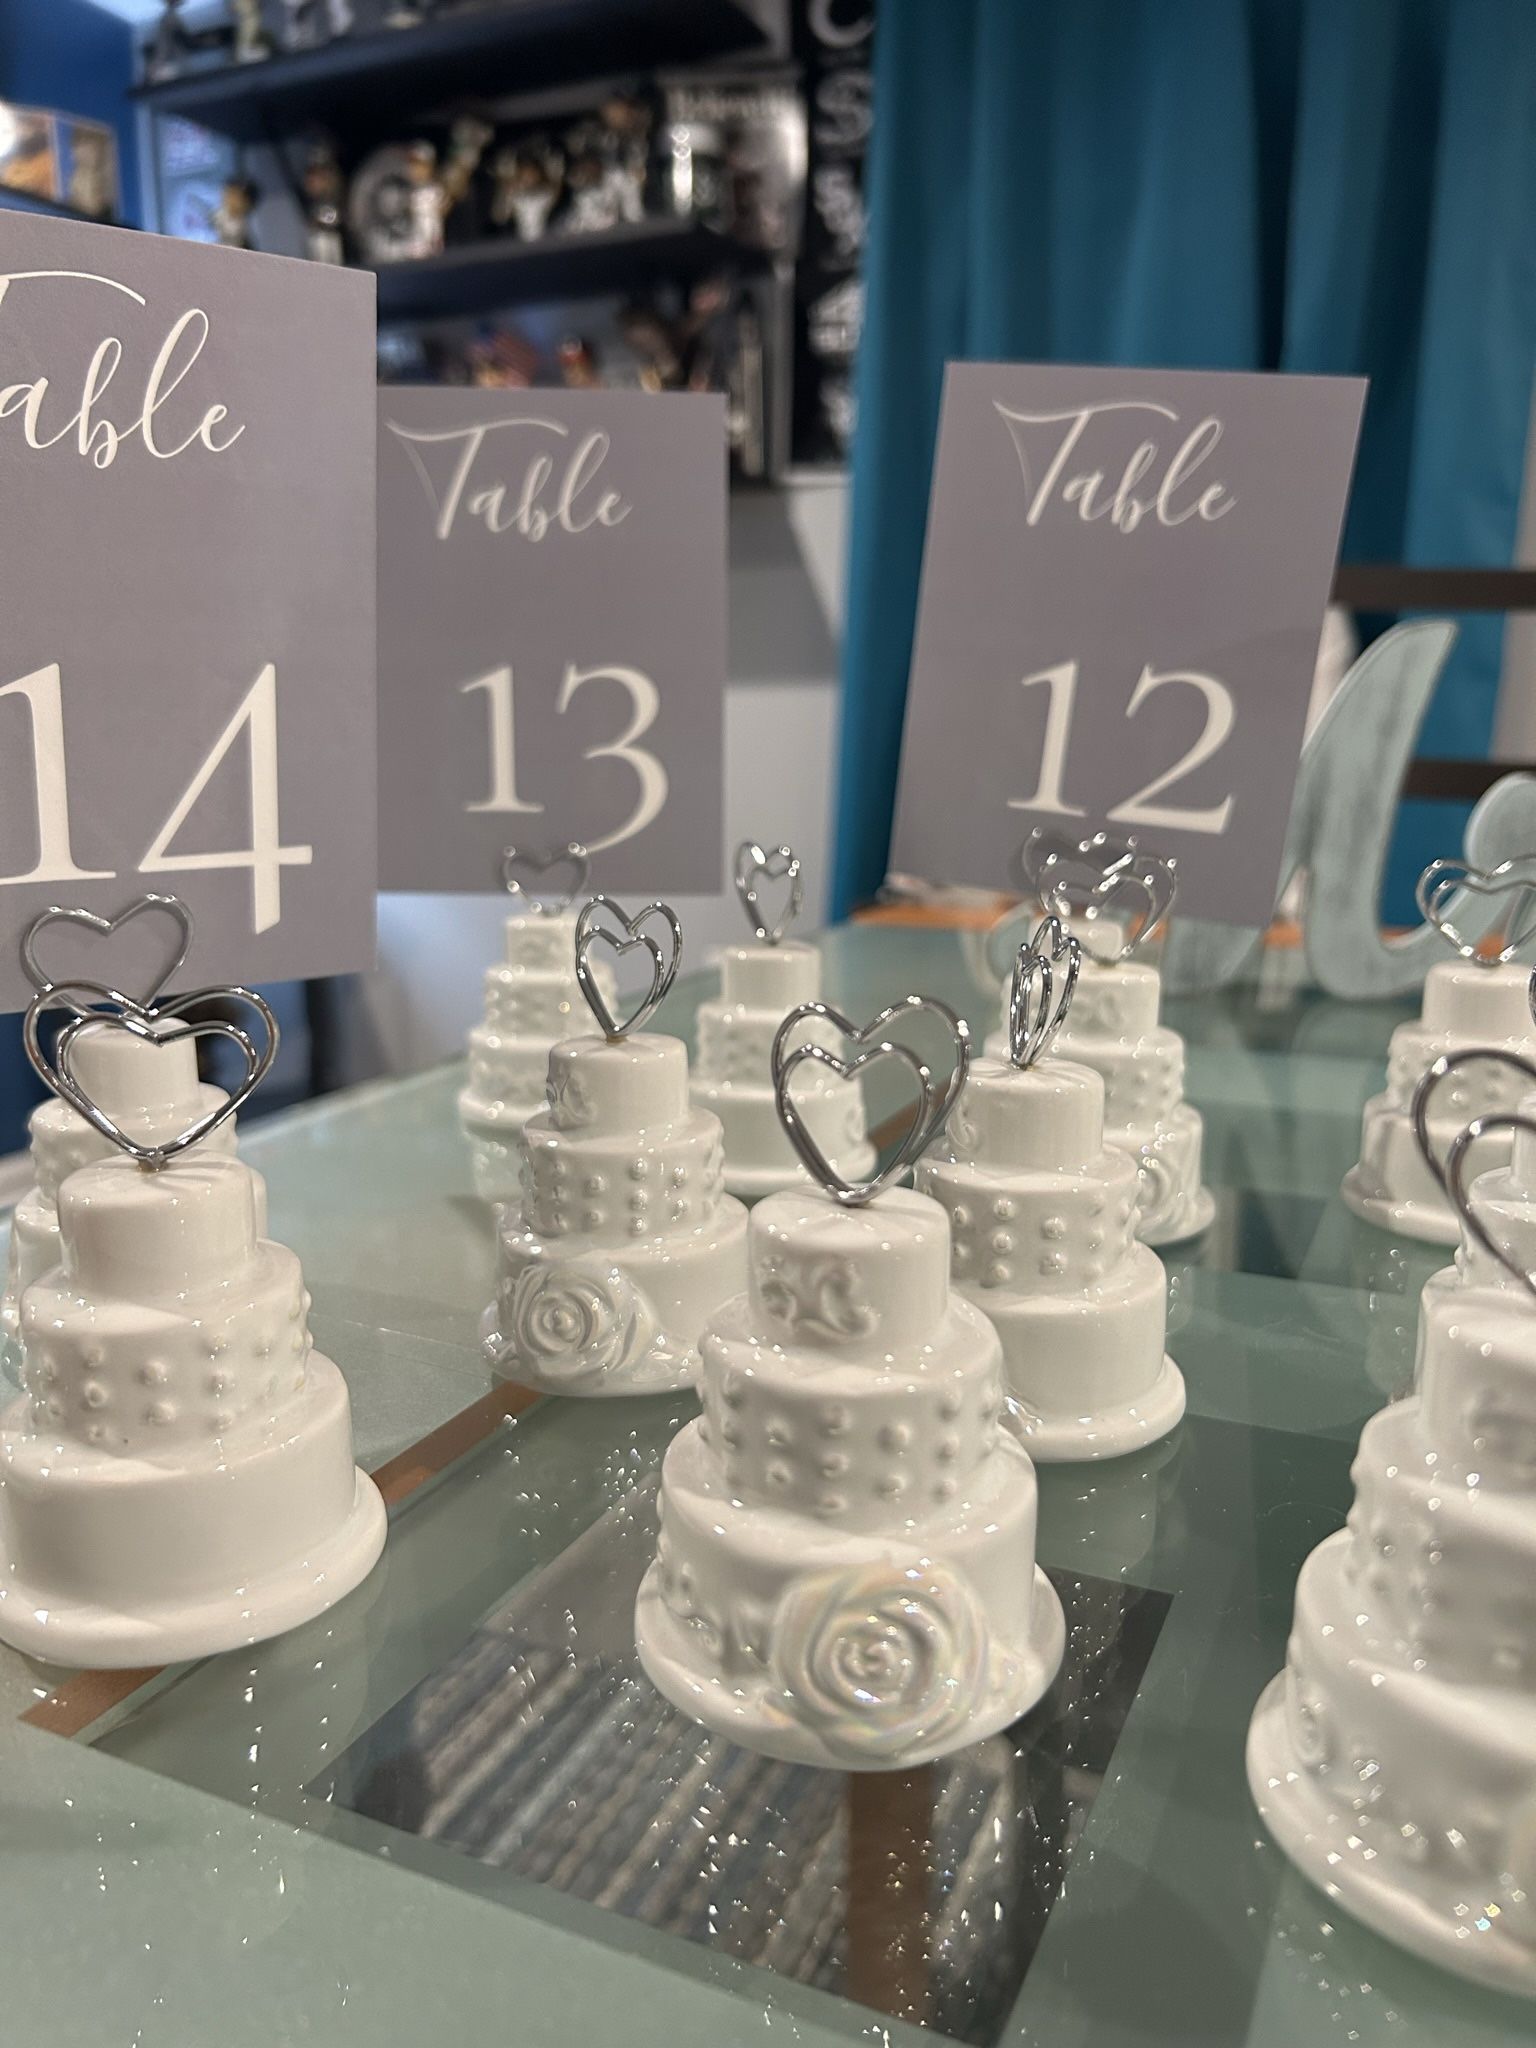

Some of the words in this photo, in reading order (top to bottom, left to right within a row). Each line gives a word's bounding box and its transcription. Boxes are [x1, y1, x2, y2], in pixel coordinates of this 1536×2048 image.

[385, 416, 634, 542] Table
[992, 400, 1237, 533] Table
[0, 662, 313, 934] 14
[458, 663, 670, 855] 13
[1006, 658, 1236, 835] 12
